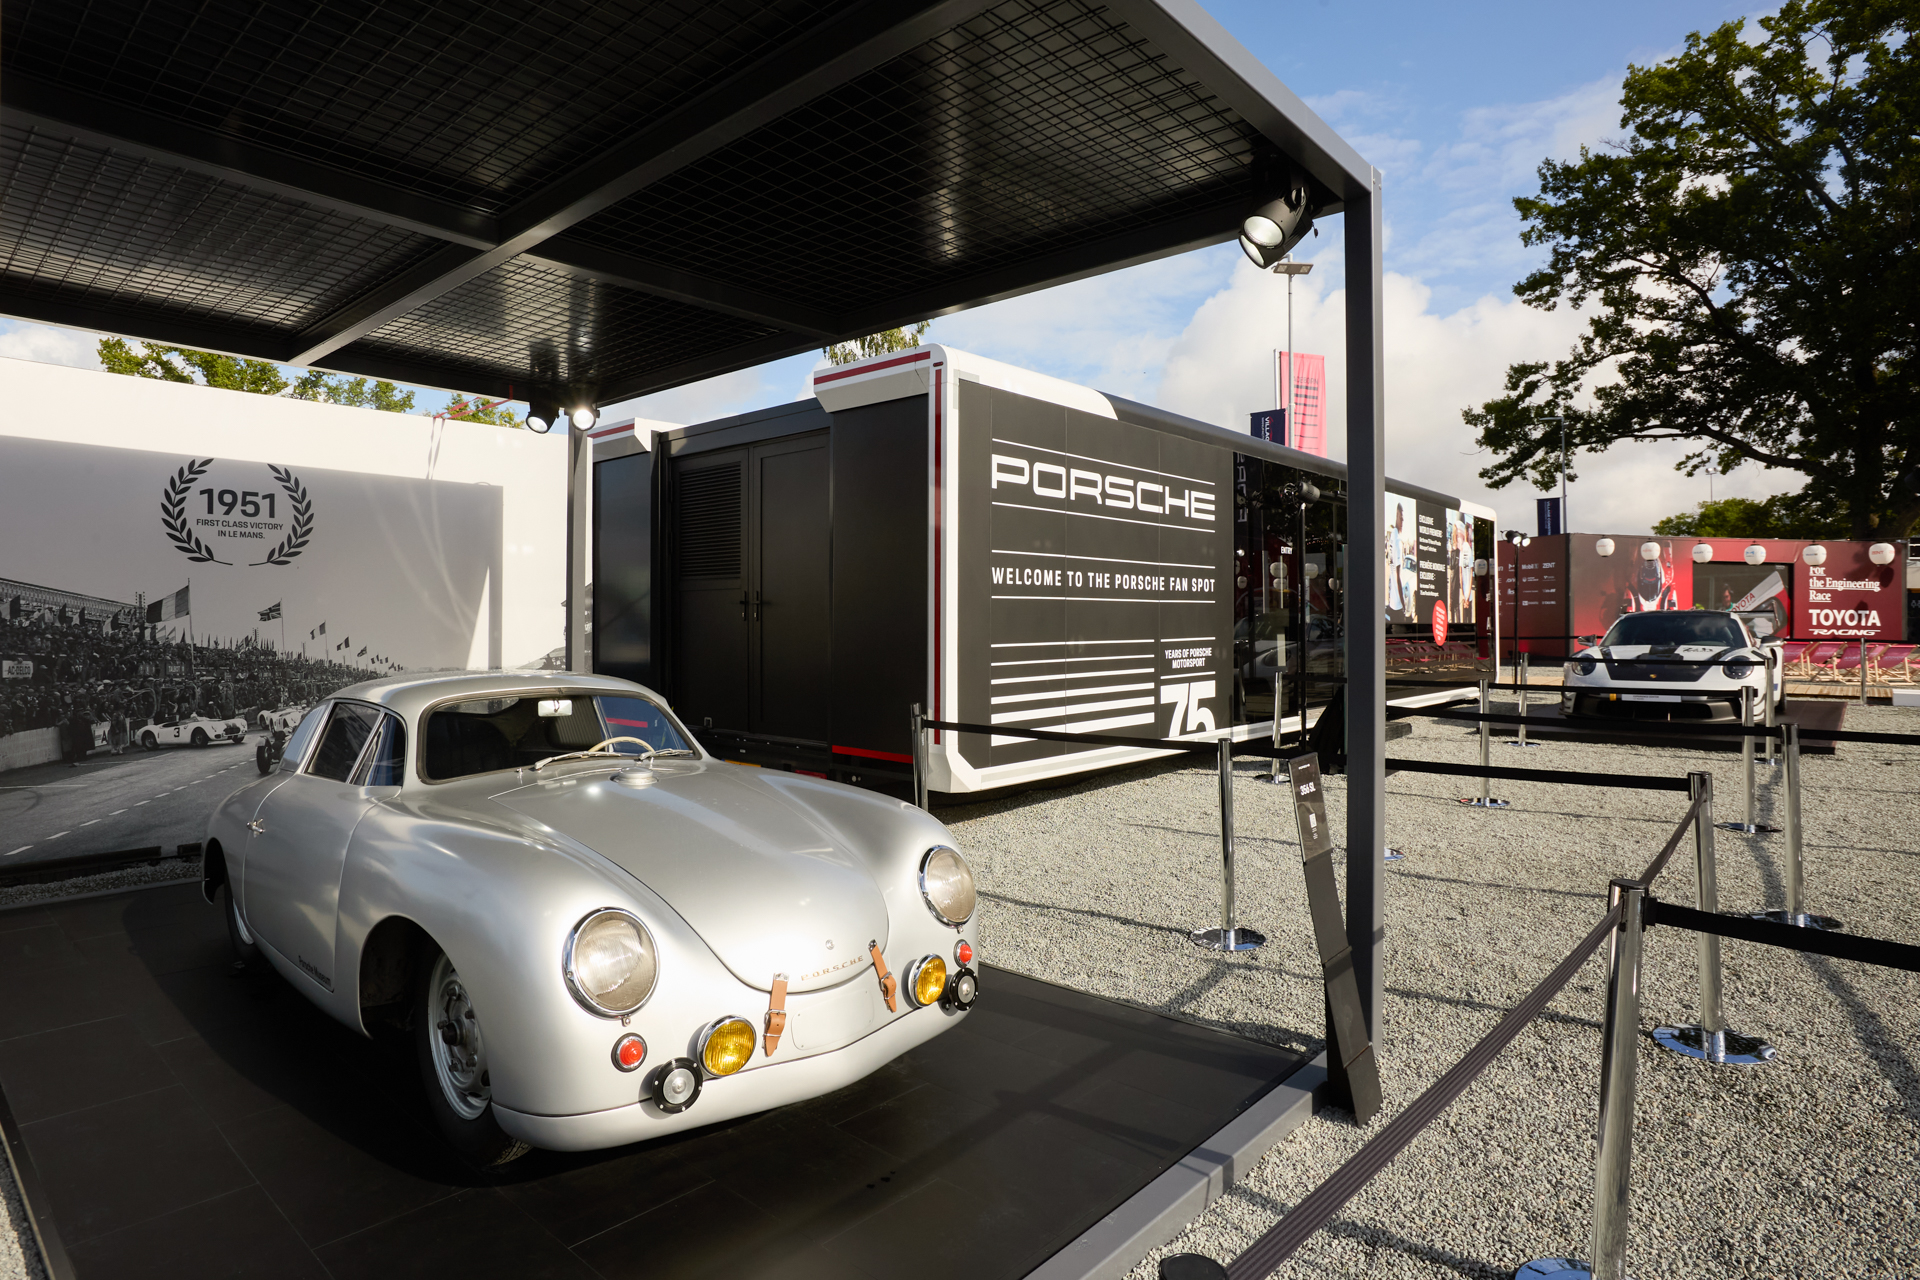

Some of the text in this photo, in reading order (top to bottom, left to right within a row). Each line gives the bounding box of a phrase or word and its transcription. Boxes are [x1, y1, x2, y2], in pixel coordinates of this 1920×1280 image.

[991, 453, 1216, 521] PORSCHE
[199, 488, 276, 518] 1951
[196, 518, 284, 531] FIRST CLASS VICTORY
[217, 529, 266, 539] IN LE MANS.
[1809, 566, 1826, 575] For
[991, 566, 1216, 593] WELCOME TO THE PORSCHE FAN SPOT
[1809, 577, 1880, 592] the Engineering
[1731, 592, 1756, 611] OYOTA
[1809, 590, 1832, 601] Race
[1808, 609, 1882, 627] TOYOTA
[1164, 647, 1213, 659] YEARS OF PORSCHE
[1171, 658, 1206, 669] MOTORSPORT
[1160, 680, 1216, 738] 75
[173, 727, 181, 738] 3
[800, 955, 864, 981] PORSCHE
